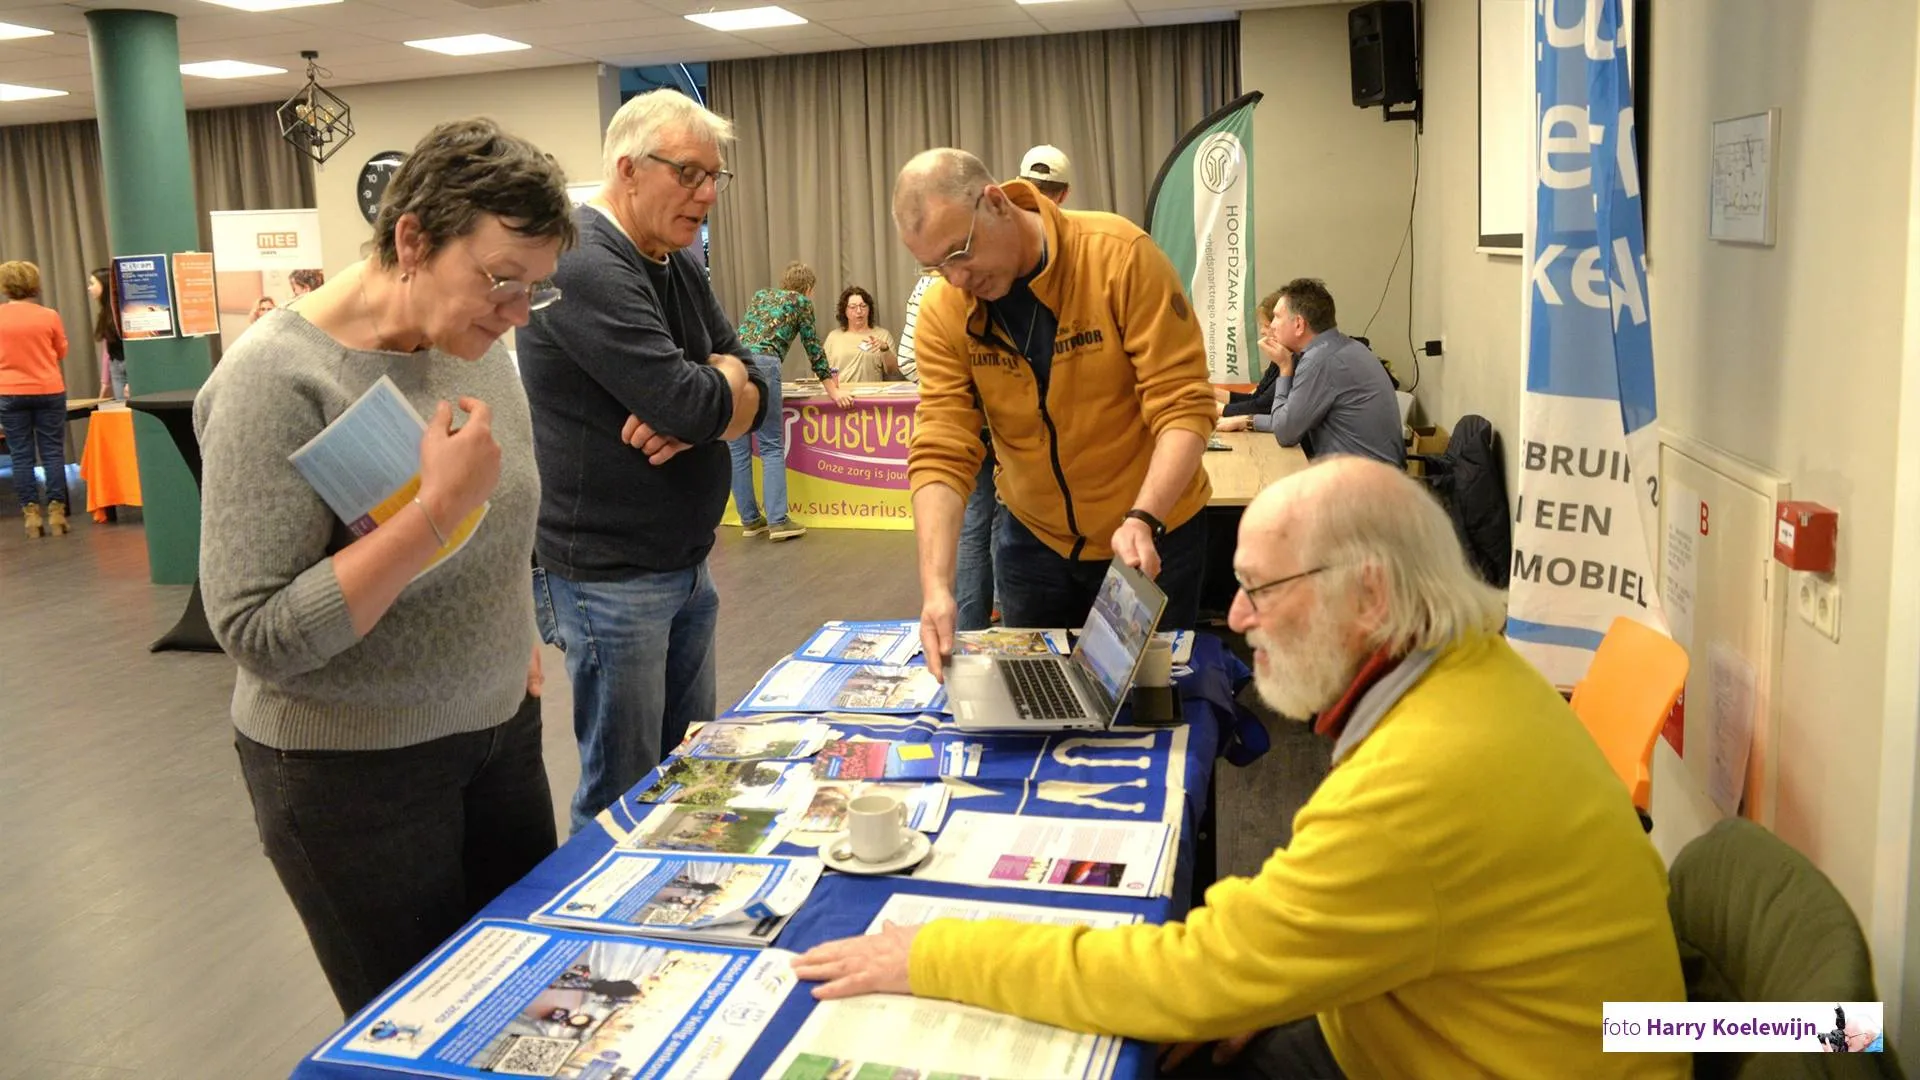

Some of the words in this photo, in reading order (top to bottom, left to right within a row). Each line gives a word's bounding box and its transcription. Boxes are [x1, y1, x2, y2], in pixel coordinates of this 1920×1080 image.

[366, 173, 377, 184] 10
[258, 233, 297, 248] MEE
[1225, 204, 1239, 312] HOOFDZAAK
[1055, 329, 1103, 354] UTDOOR
[1226, 326, 1239, 377] WERK
[969, 352, 1000, 366] TLANTIC
[817, 460, 845, 474] Onze
[847, 466, 872, 479] zorg
[874, 468, 884, 479] is
[1524, 440, 1631, 484] BRUI
[788, 500, 912, 519] w.sustvarius.
[1535, 499, 1612, 536] EEN
[1700, 501, 1709, 537] B
[1513, 549, 1647, 608] MOBIEL
